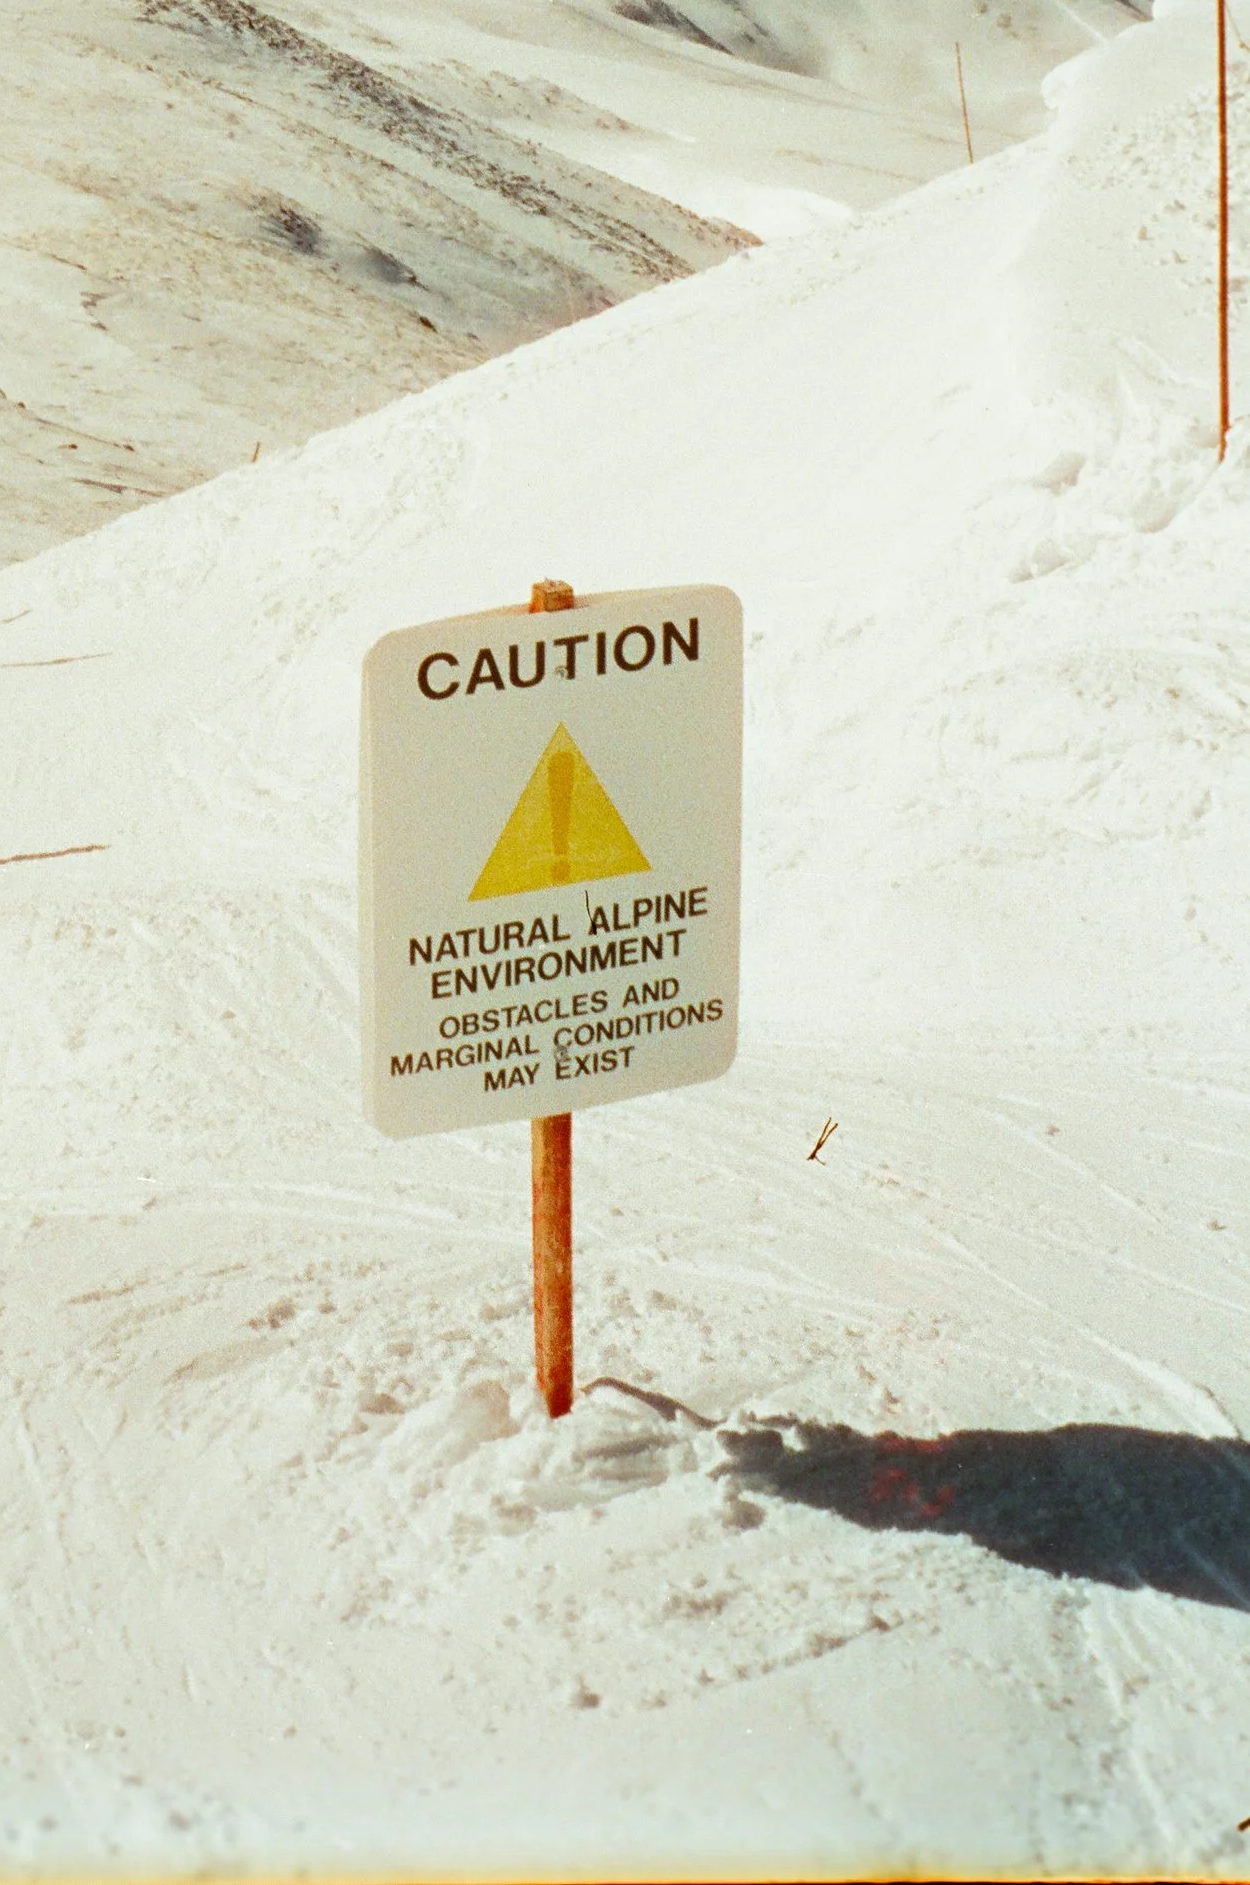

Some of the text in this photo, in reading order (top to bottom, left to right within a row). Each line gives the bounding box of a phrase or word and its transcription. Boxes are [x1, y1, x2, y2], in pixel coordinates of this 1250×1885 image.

[417, 617, 700, 701] CAUTION
[408, 886, 708, 966] NATURAL ALPINE
[431, 928, 687, 1000] ENVIRONMENT
[390, 998, 724, 1078] MARGINAL CONDITIONS
[439, 976, 680, 1040] OBSTACLES AND
[483, 1045, 635, 1093] MAY EXIST
